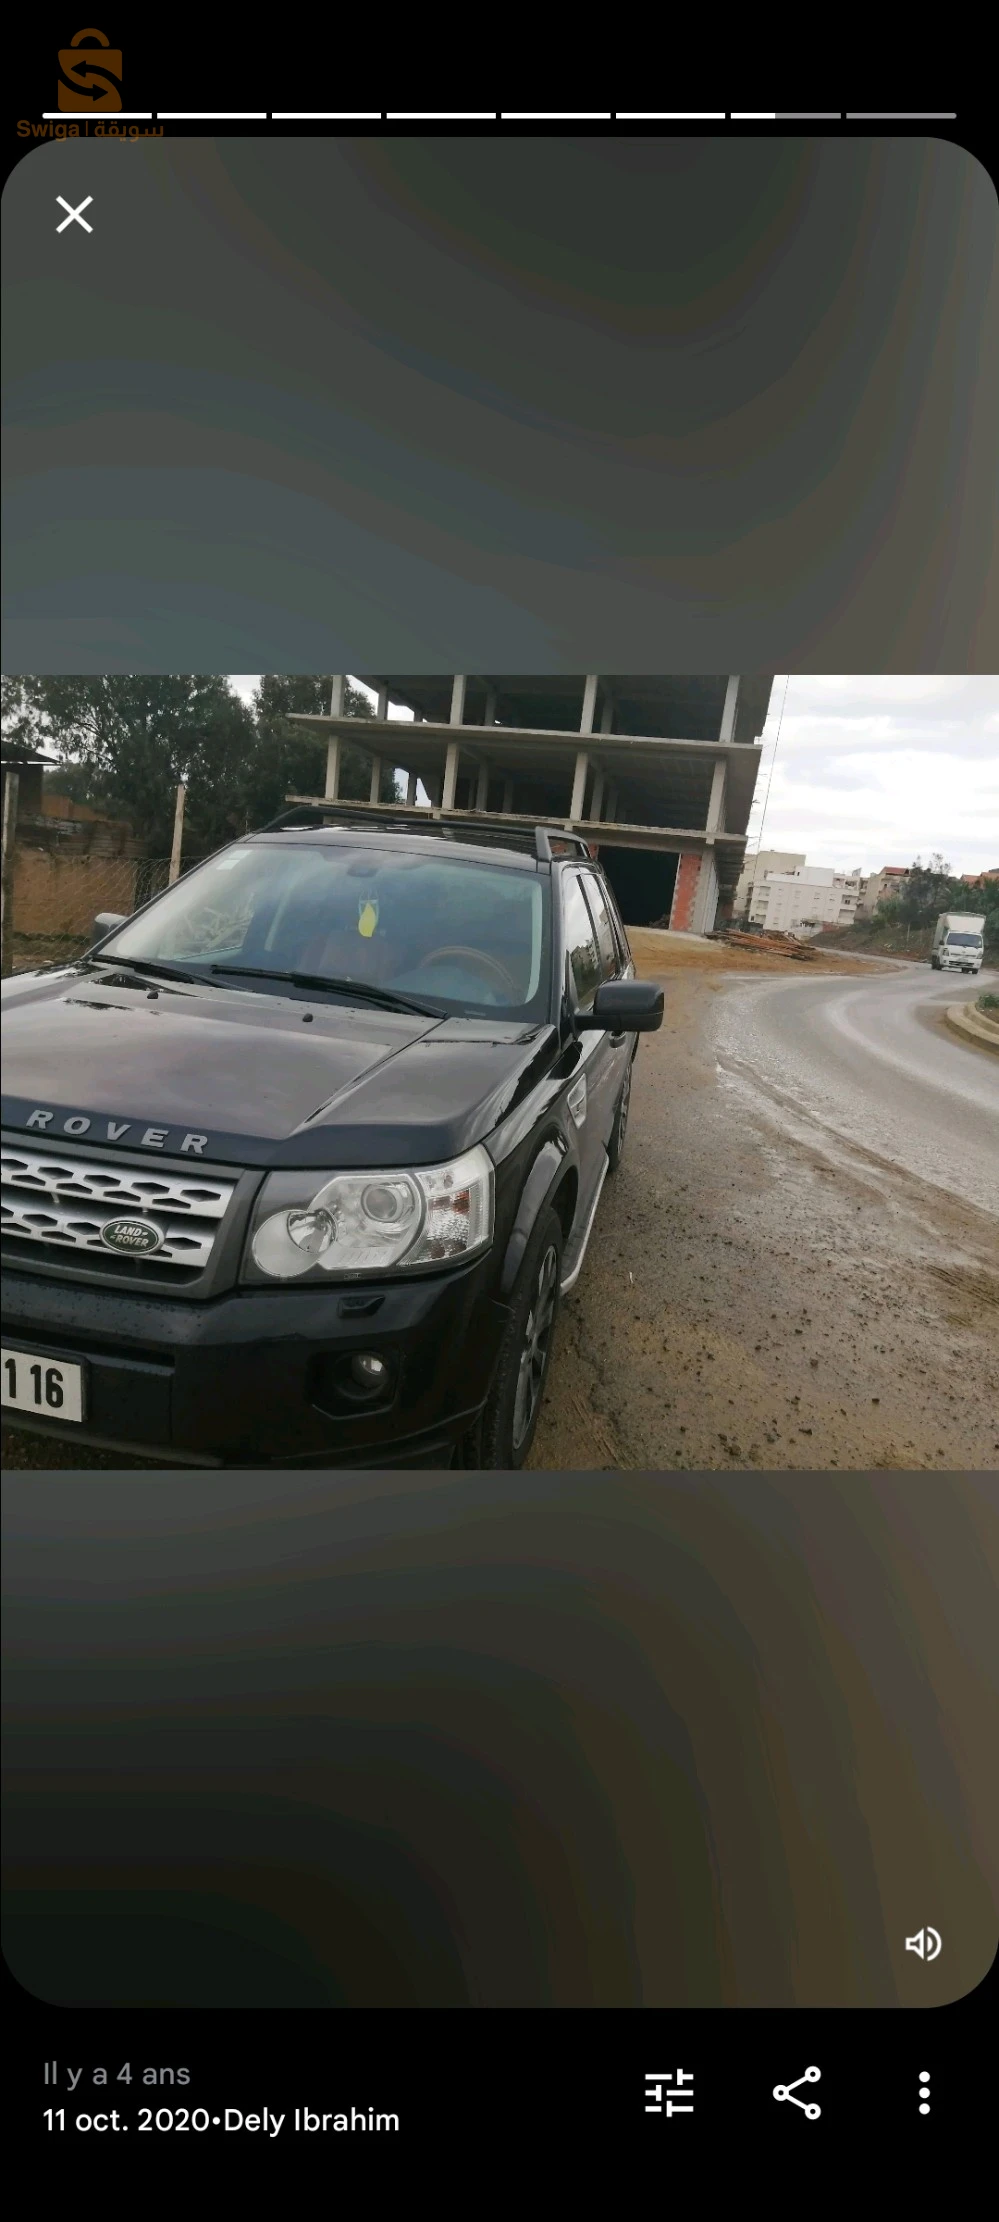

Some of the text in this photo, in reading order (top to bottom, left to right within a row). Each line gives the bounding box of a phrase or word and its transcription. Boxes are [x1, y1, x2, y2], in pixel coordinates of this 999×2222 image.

[26, 1109, 209, 1155] ROVER
[114, 1225, 142, 1236] LAND
[115, 1235, 149, 1247] ROVER
[29, 1364, 64, 1408] 16
